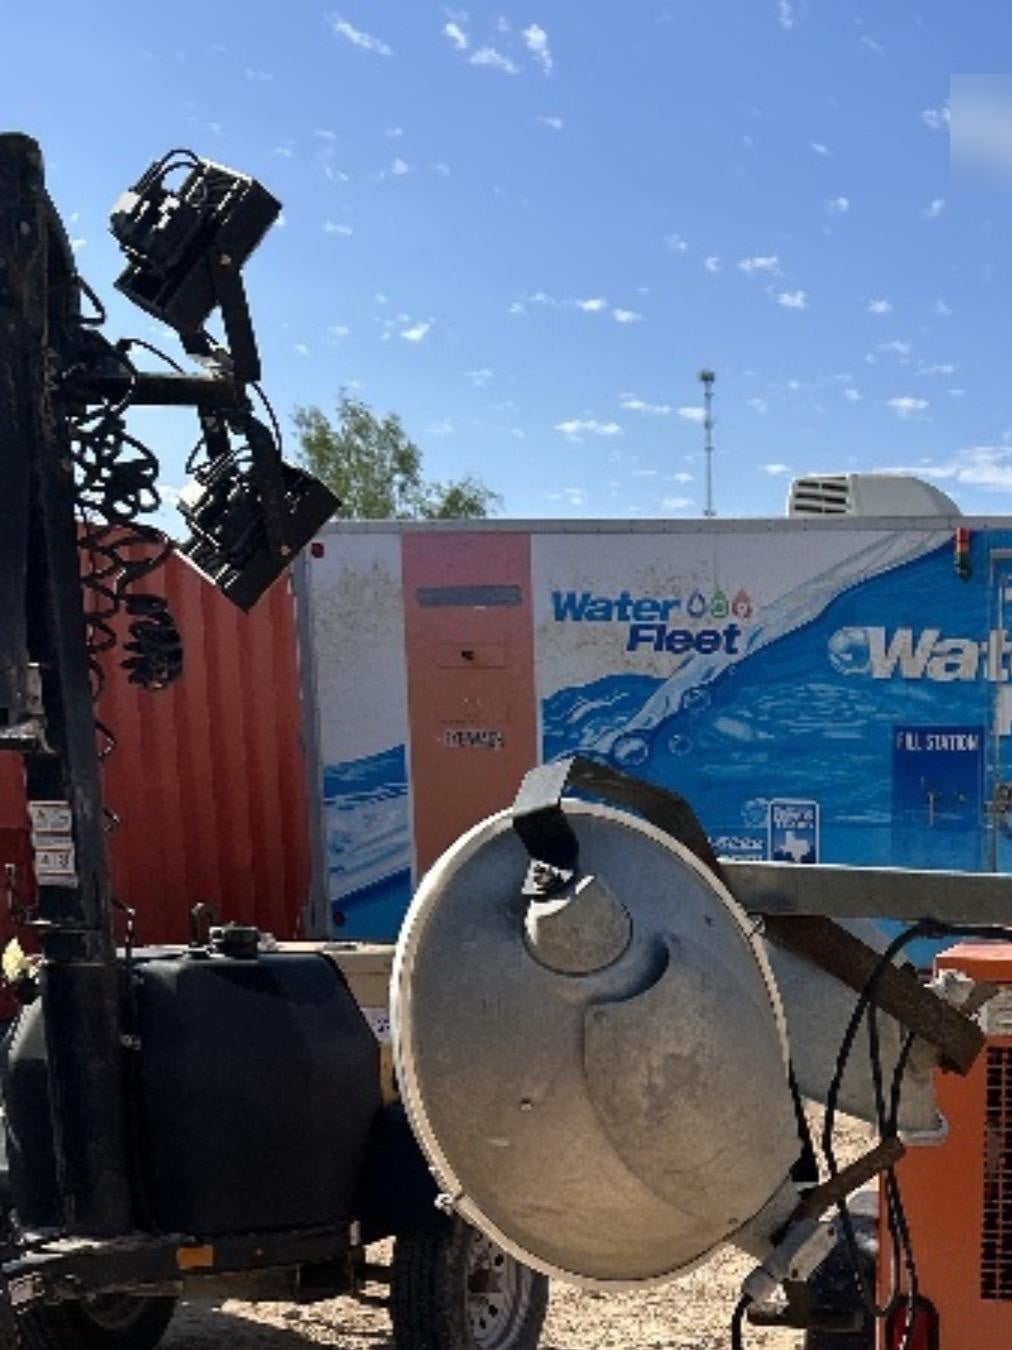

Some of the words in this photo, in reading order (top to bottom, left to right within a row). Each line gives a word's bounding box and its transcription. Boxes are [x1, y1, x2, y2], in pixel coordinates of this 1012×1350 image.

[551, 590, 681, 622] Water
[626, 623, 741, 654] Fleet
[896, 732, 922, 751] FILL
[926, 734, 979, 751] STATION
